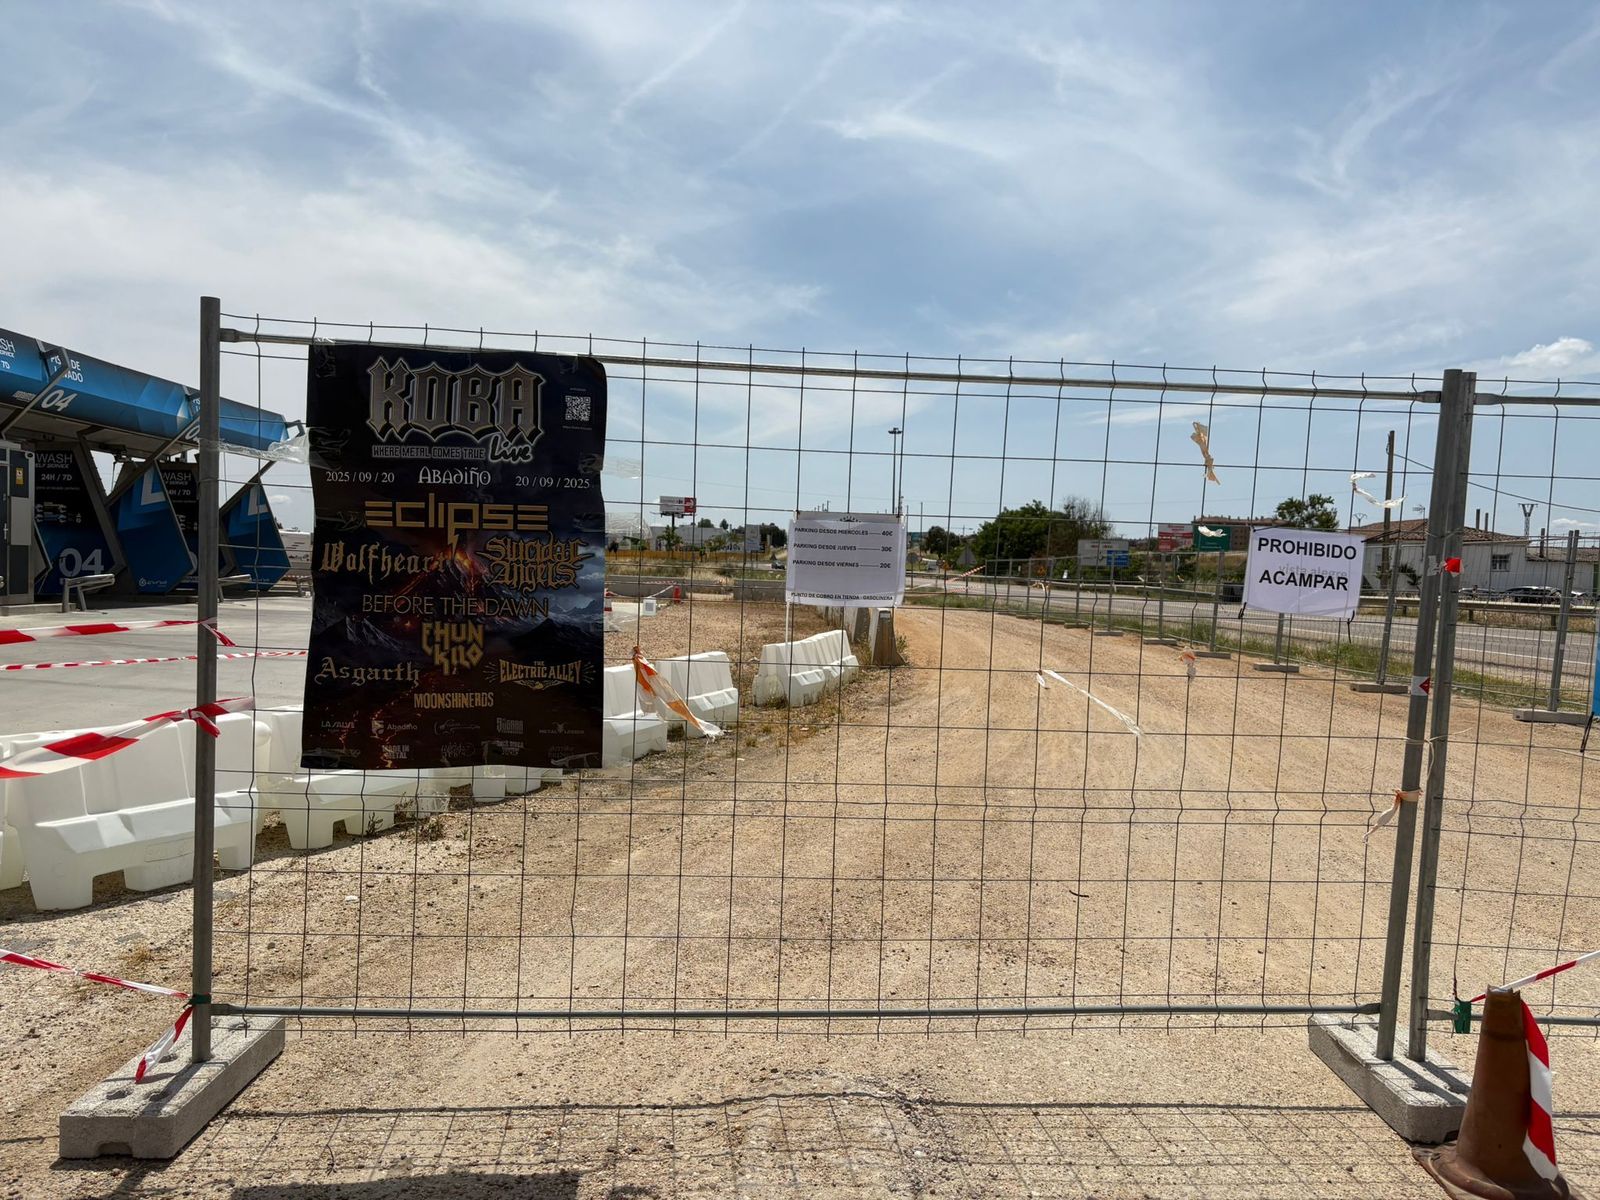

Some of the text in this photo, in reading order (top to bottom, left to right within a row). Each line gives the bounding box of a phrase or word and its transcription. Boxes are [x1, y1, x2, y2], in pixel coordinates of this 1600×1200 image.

[71, 359, 81, 371] DE
[41, 389, 78, 412] 04
[366, 356, 545, 446] KOBA
[36, 453, 73, 464] WASH
[372, 445, 485, 459] WHERE METAL COMES TRUE
[489, 433, 533, 463] Live
[41, 473, 56, 481] 24H
[326, 471, 350, 482] 2025
[359, 472, 372, 482] 09
[382, 472, 395, 483] 20
[515, 476, 529, 487] 20
[540, 477, 553, 488] 09
[564, 478, 590, 489] 2025
[1258, 537, 1357, 560] PROHIBIDO
[59, 548, 104, 577] 04
[319, 539, 447, 585] Wolfheart
[1259, 570, 1349, 591] ACAMPAR
[362, 595, 549, 617] BEFORE THE DAWN
[314, 657, 421, 688] Asgarth
[499, 659, 583, 685] ELECTRIC ALLEY
[414, 692, 495, 709] MOONSHINERDS
